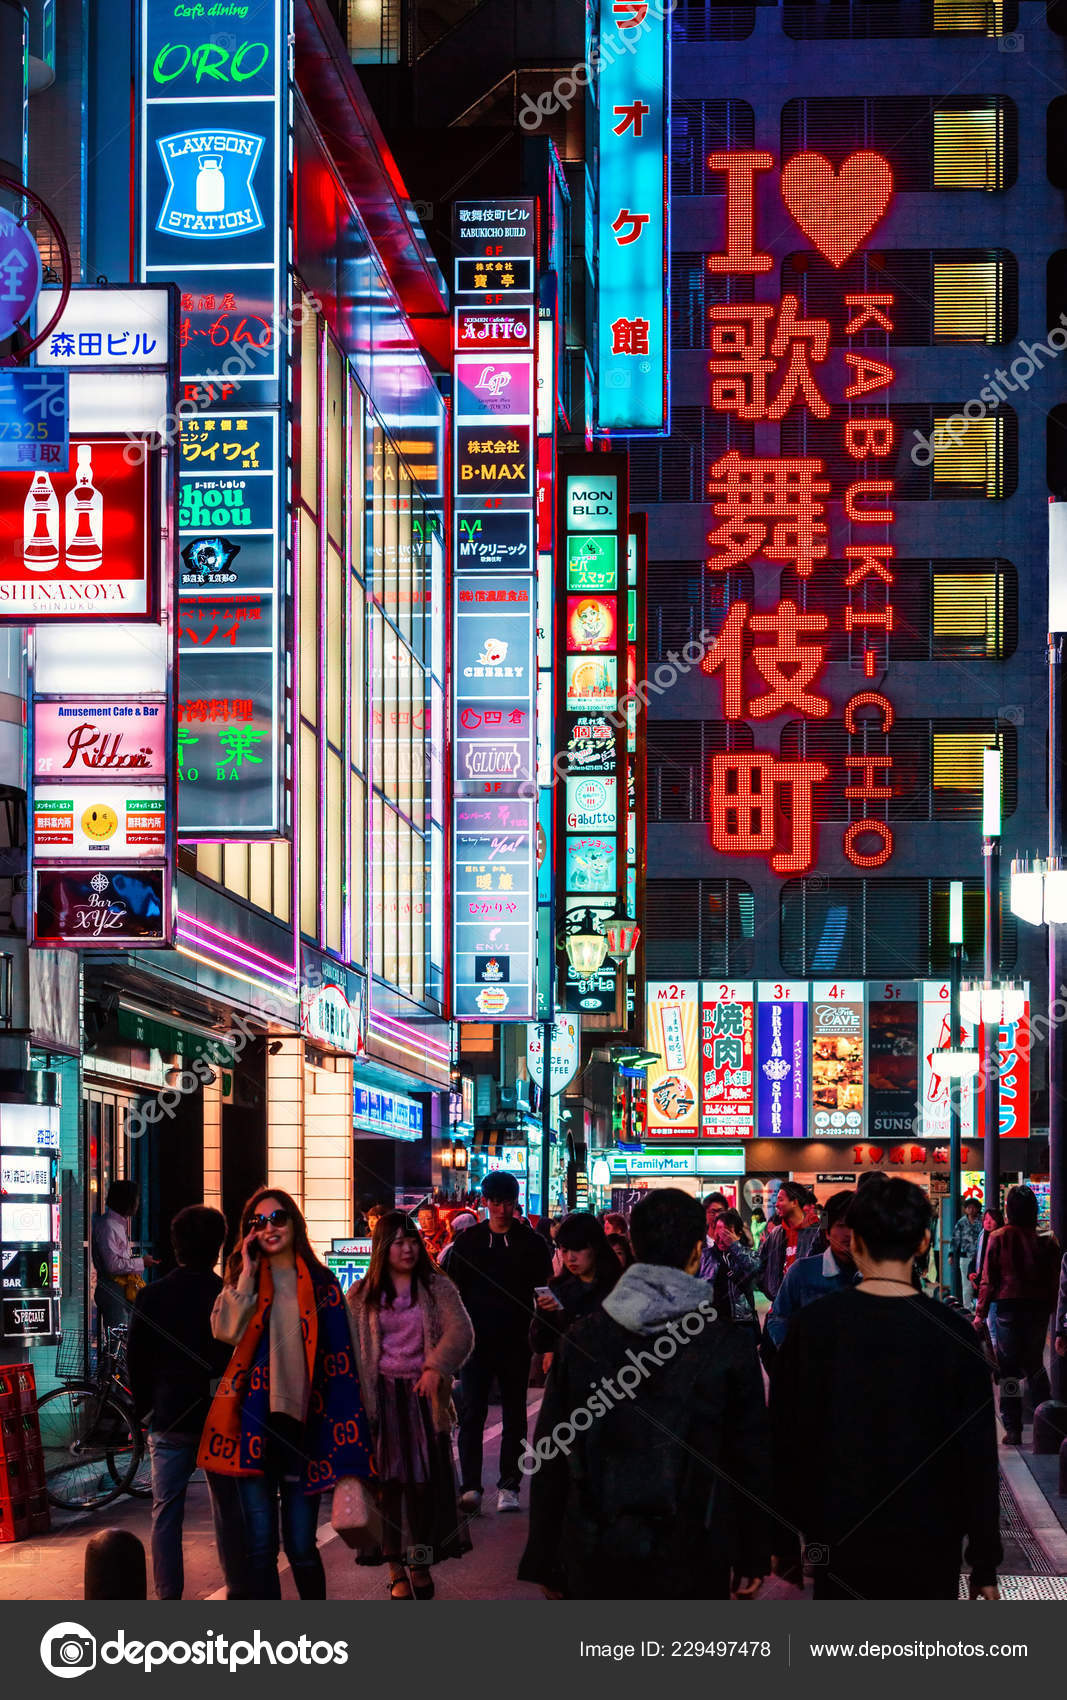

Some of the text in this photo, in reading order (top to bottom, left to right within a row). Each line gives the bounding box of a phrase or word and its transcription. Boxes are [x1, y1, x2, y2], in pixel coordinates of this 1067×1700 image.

[174, 4, 249, 18] Cafe dining
[152, 41, 269, 84] ORO
[168, 136, 254, 158] LAWSON
[459, 208, 530, 222] 歌舞伎町ビル
[708, 153, 774, 272] I
[169, 209, 254, 231] STATION
[461, 227, 527, 238] KABUKICHO BUILD
[485, 245, 504, 256] 6F
[475, 262, 513, 271] 株式会社
[180, 293, 238, 312] 居酒屋
[485, 294, 503, 305] 5F
[461, 321, 527, 339] AJITO
[50, 332, 157, 357] 森田ビル
[179, 420, 248, 431] れ家個室
[17, 444, 61, 462] 買取
[182, 441, 260, 462] ワイワイ
[467, 440, 520, 454] 株式会社
[242, 460, 259, 468] 東京
[179, 484, 244, 508] hou
[573, 491, 613, 500] MON
[484, 498, 503, 509] 4F
[573, 506, 613, 515] BLD.
[460, 543, 527, 555] MYクリニック
[182, 574, 205, 584] BAR
[702, 294, 832, 874] 歌舞伎町
[844, 294, 895, 870] KABUKI-CHO
[0, 583, 127, 600] SHINANOYA
[32, 602, 94, 610] SHINJUKU
[182, 607, 262, 621] ベトナム料理
[178, 622, 240, 646] ハノイ
[464, 667, 524, 677] CHERRY
[58, 706, 159, 716] Amusement Cafe & Bar
[573, 726, 612, 739] 個室
[567, 737, 616, 750] ダイニング
[39, 758, 53, 771] 2F
[473, 747, 513, 773] GLÜCK
[603, 762, 617, 771] 3F
[216, 767, 240, 781] BA
[485, 782, 503, 792] 3F
[37, 817, 72, 829] 無料案内所
[127, 817, 162, 829] 無料案内所
[567, 812, 616, 829] Gabutto
[88, 893, 111, 907] Bar
[468, 902, 517, 914] ひかりや
[73, 909, 127, 936] XYZ
[657, 984, 687, 1000] M2F
[719, 984, 736, 1000] 2F
[773, 984, 791, 1000] 3F
[828, 984, 846, 999] 4F
[883, 984, 901, 1000] 5F
[713, 1002, 744, 1070] 焼肉
[771, 1005, 783, 1057] DREAM
[536, 1066, 569, 1074] CFFEE
[772, 1081, 783, 1134] STORE
[631, 1158, 689, 1170] FamilyMart
[3, 1278, 22, 1288] BAR
